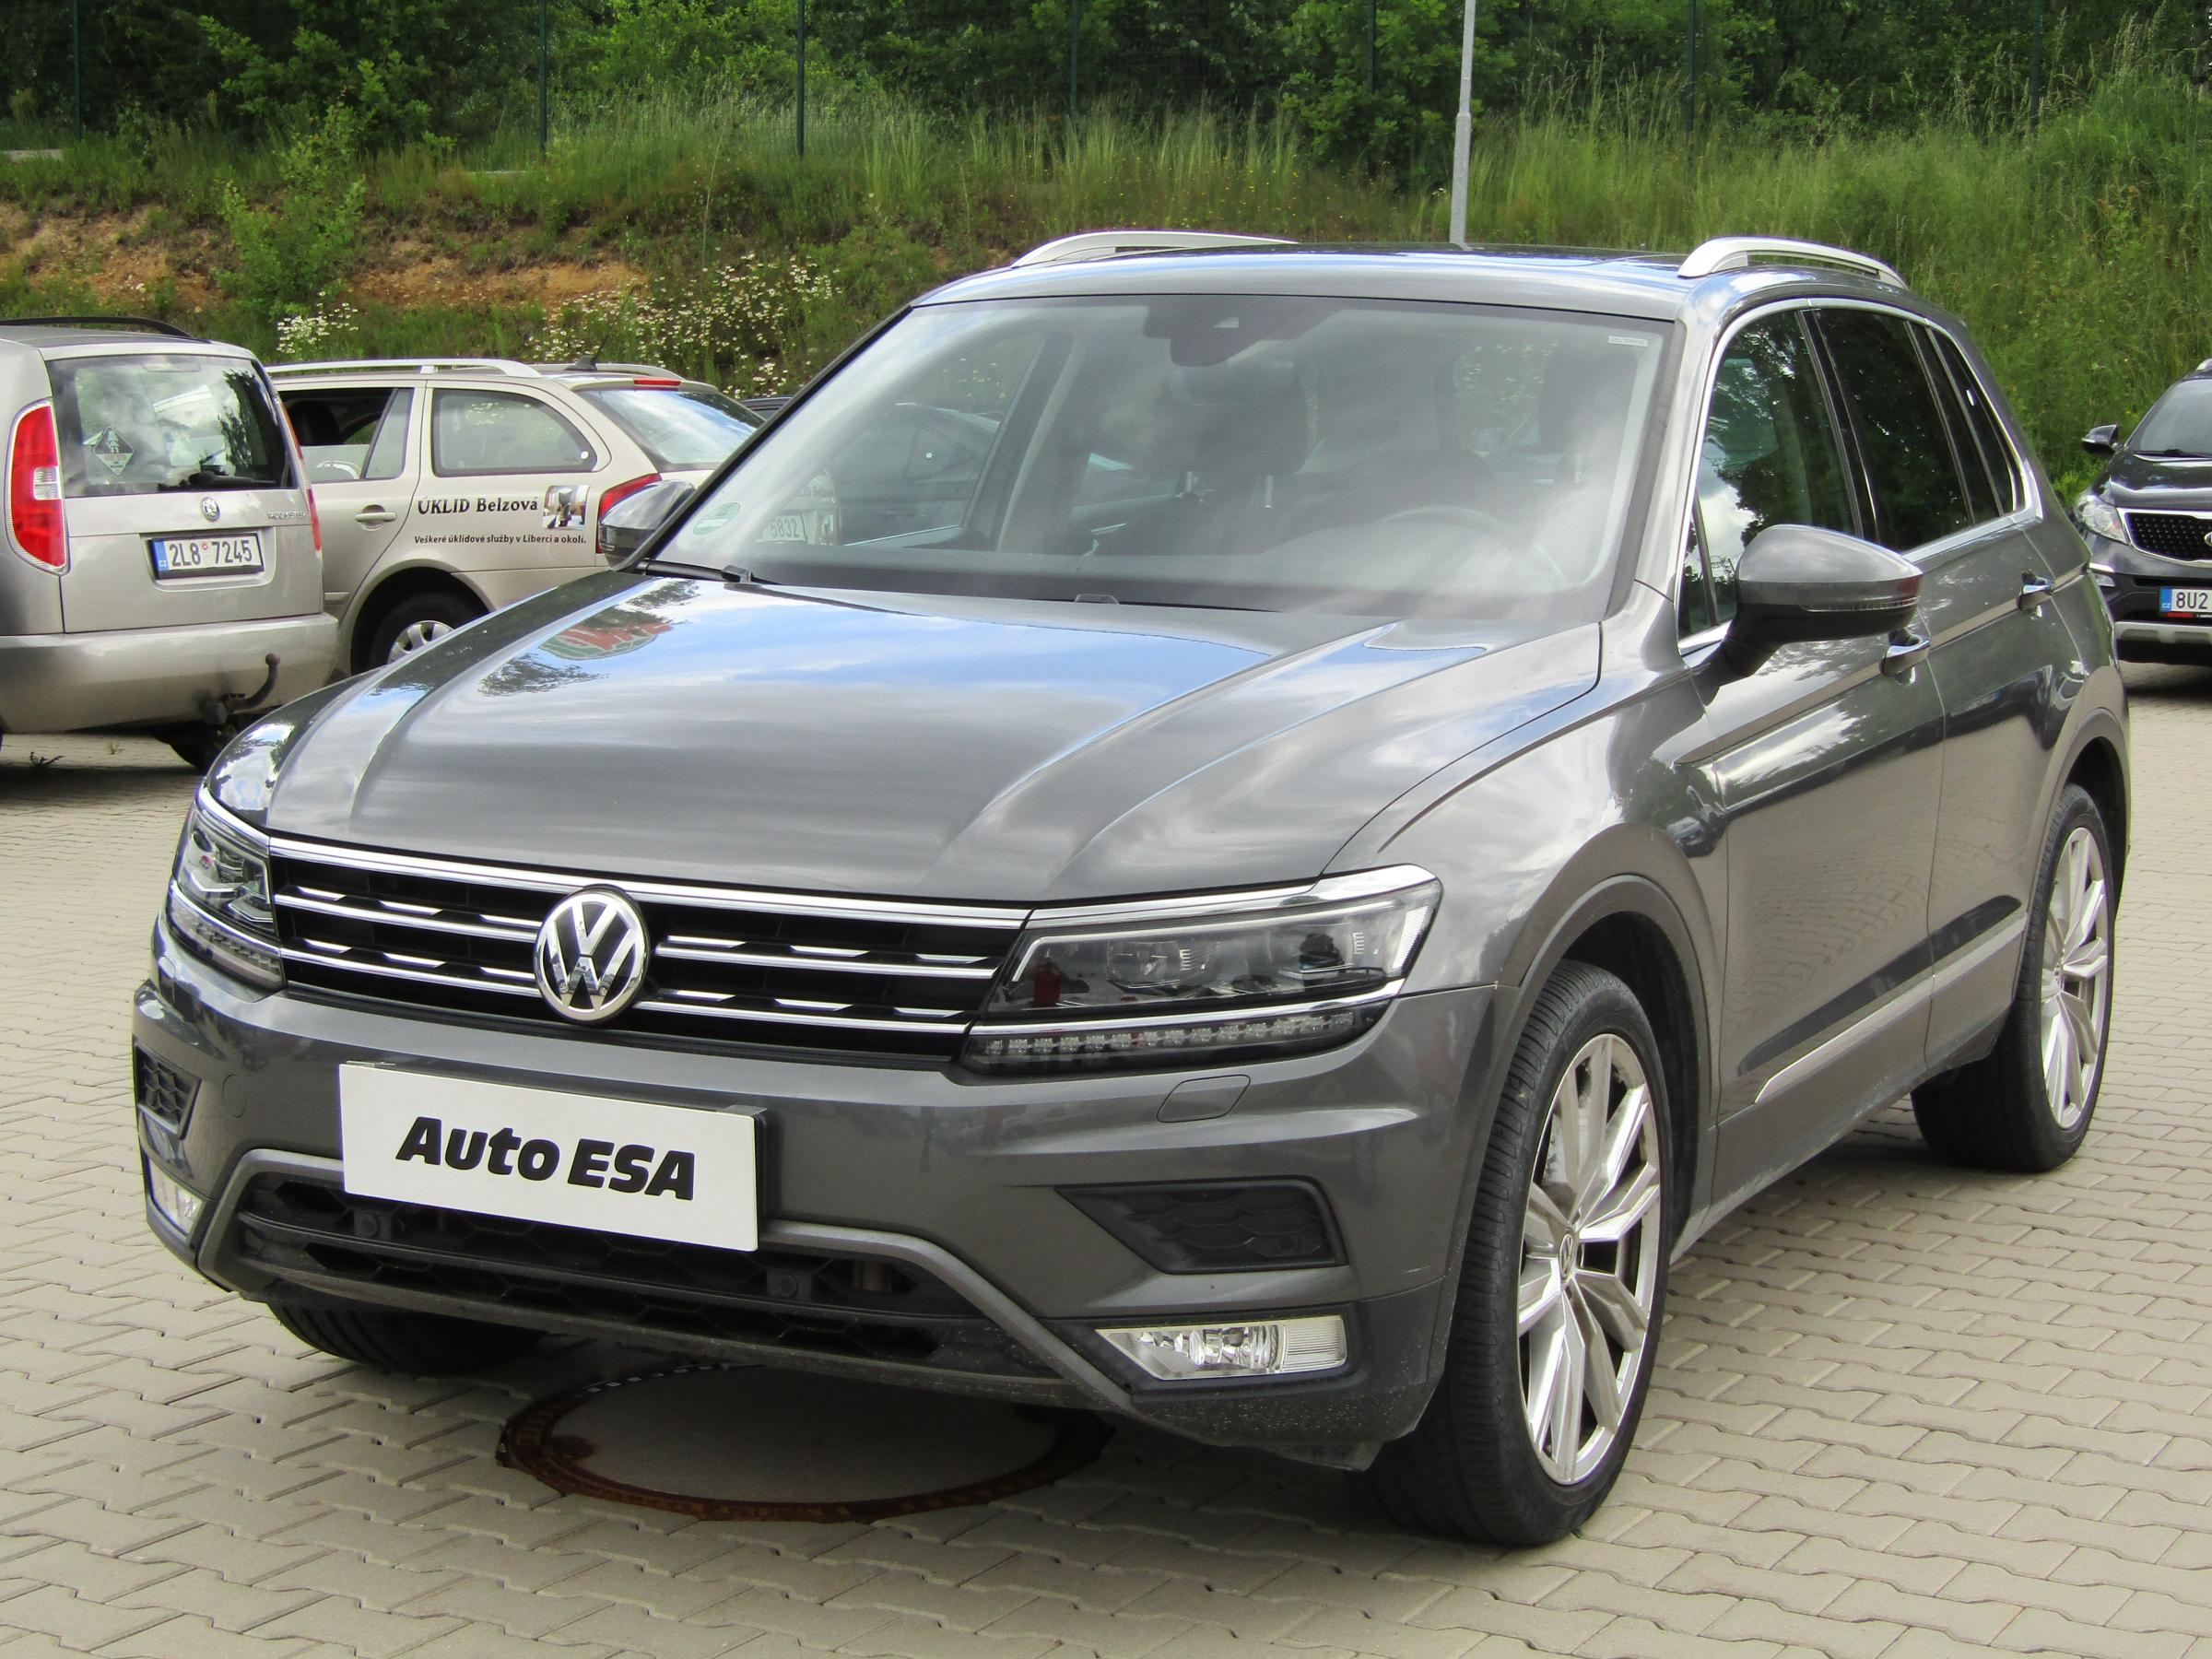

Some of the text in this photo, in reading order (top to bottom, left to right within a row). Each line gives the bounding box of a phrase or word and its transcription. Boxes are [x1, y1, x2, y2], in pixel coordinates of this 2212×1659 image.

[418, 497, 538, 514] ÚKLID Belzová
[415, 535, 447, 544] Veškeré
[448, 534, 486, 543] úklidové
[487, 535, 514, 545] služby
[523, 535, 553, 544] Liberci
[170, 542, 202, 567] 2L8
[211, 539, 253, 564] 7245
[2176, 591, 2208, 609] 8U2
[395, 1116, 695, 1201] Auto ESA
